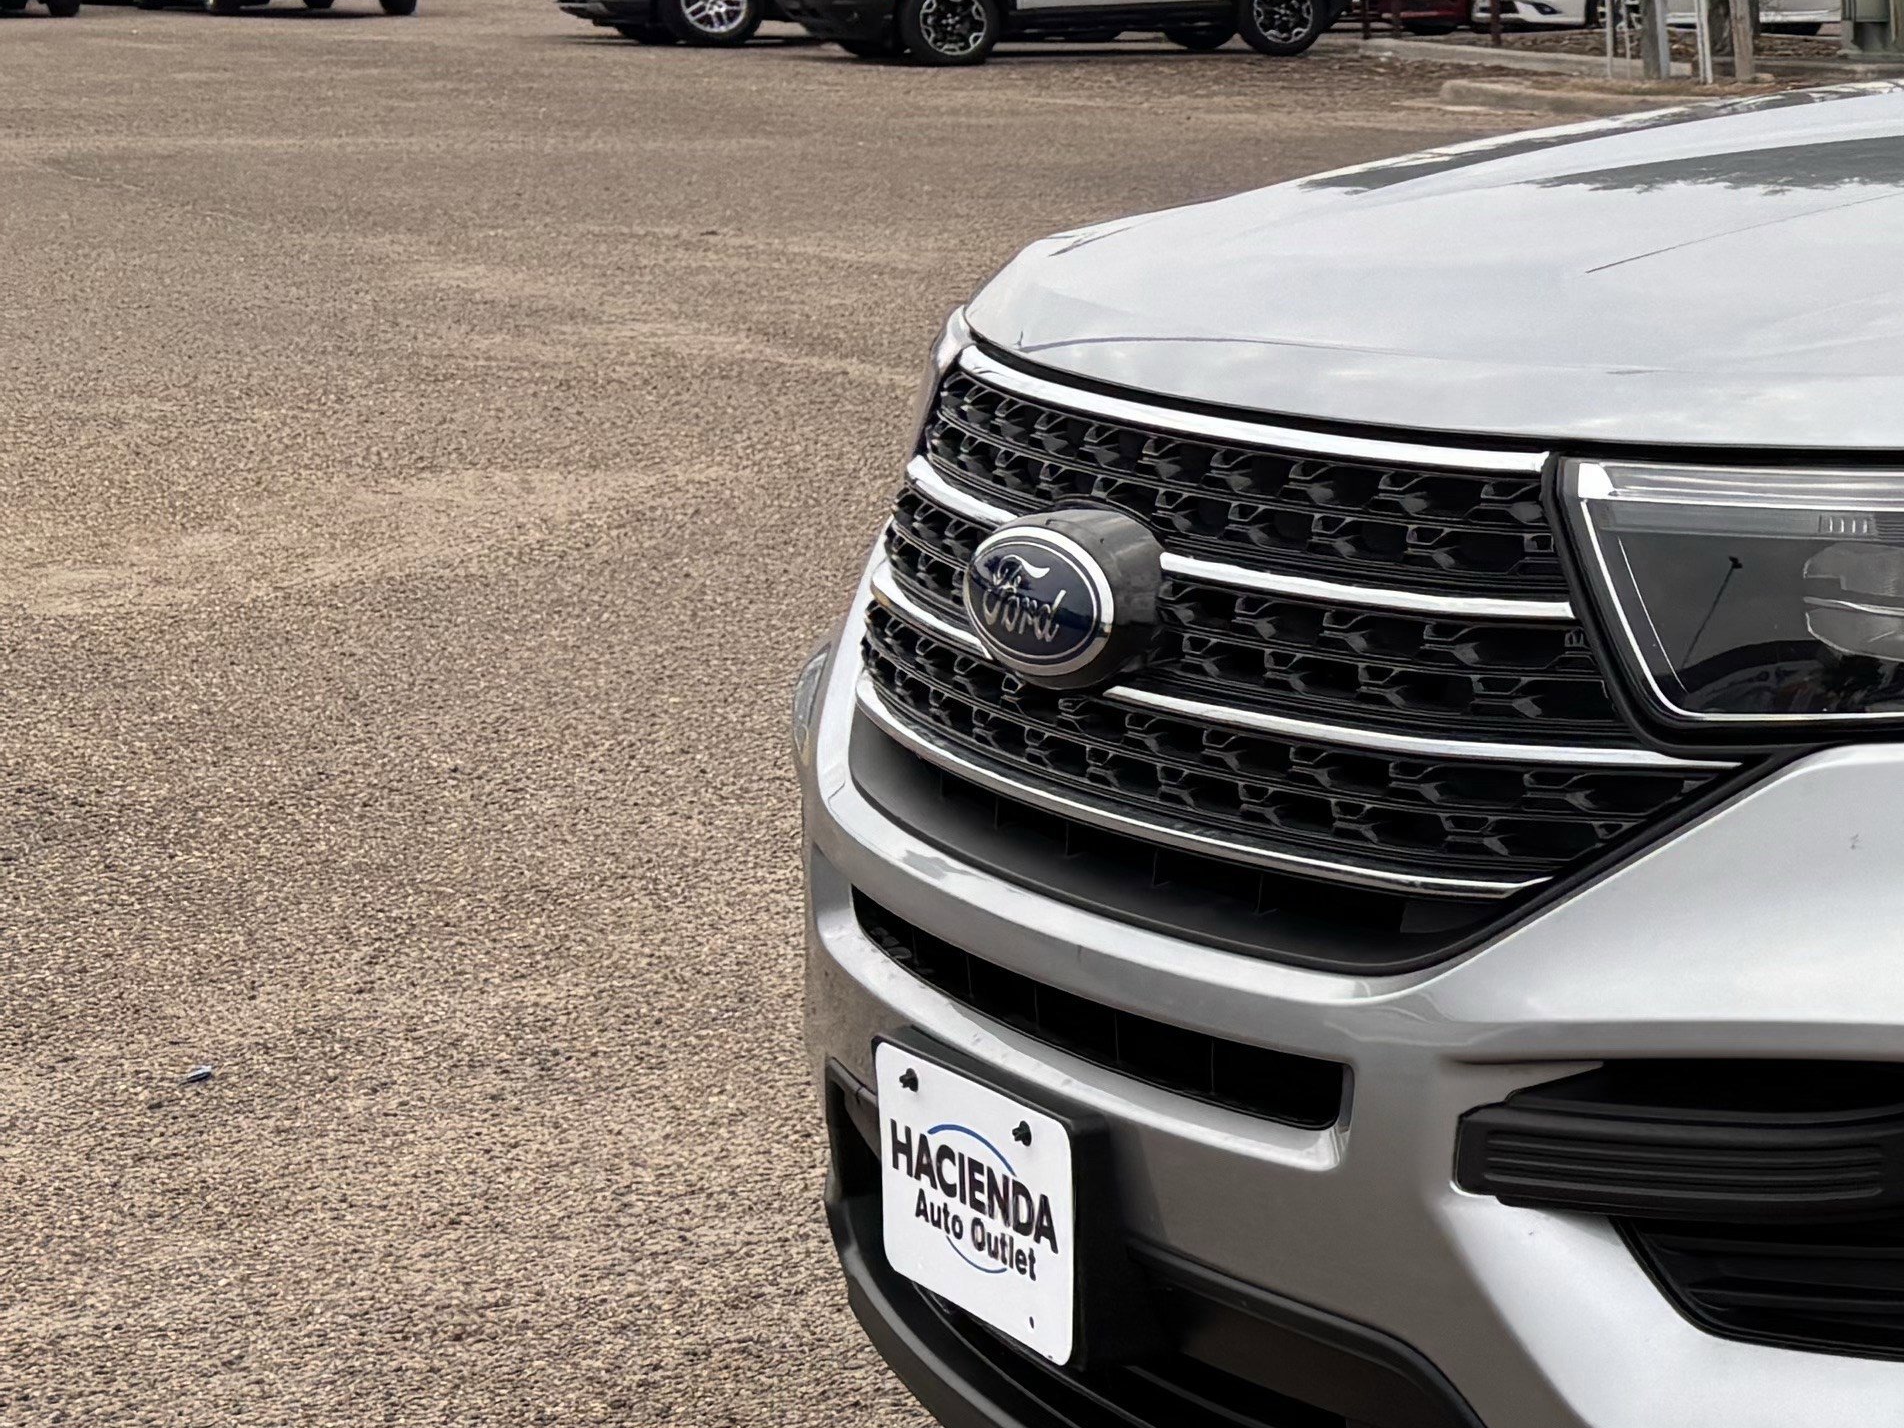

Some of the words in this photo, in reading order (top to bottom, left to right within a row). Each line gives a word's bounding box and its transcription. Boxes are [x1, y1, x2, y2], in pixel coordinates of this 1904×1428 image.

[982, 554, 1067, 643] Ford
[890, 1118, 1059, 1255] HACIENDA
[915, 1188, 964, 1241] Auto
[971, 1217, 1037, 1282] Outlet
